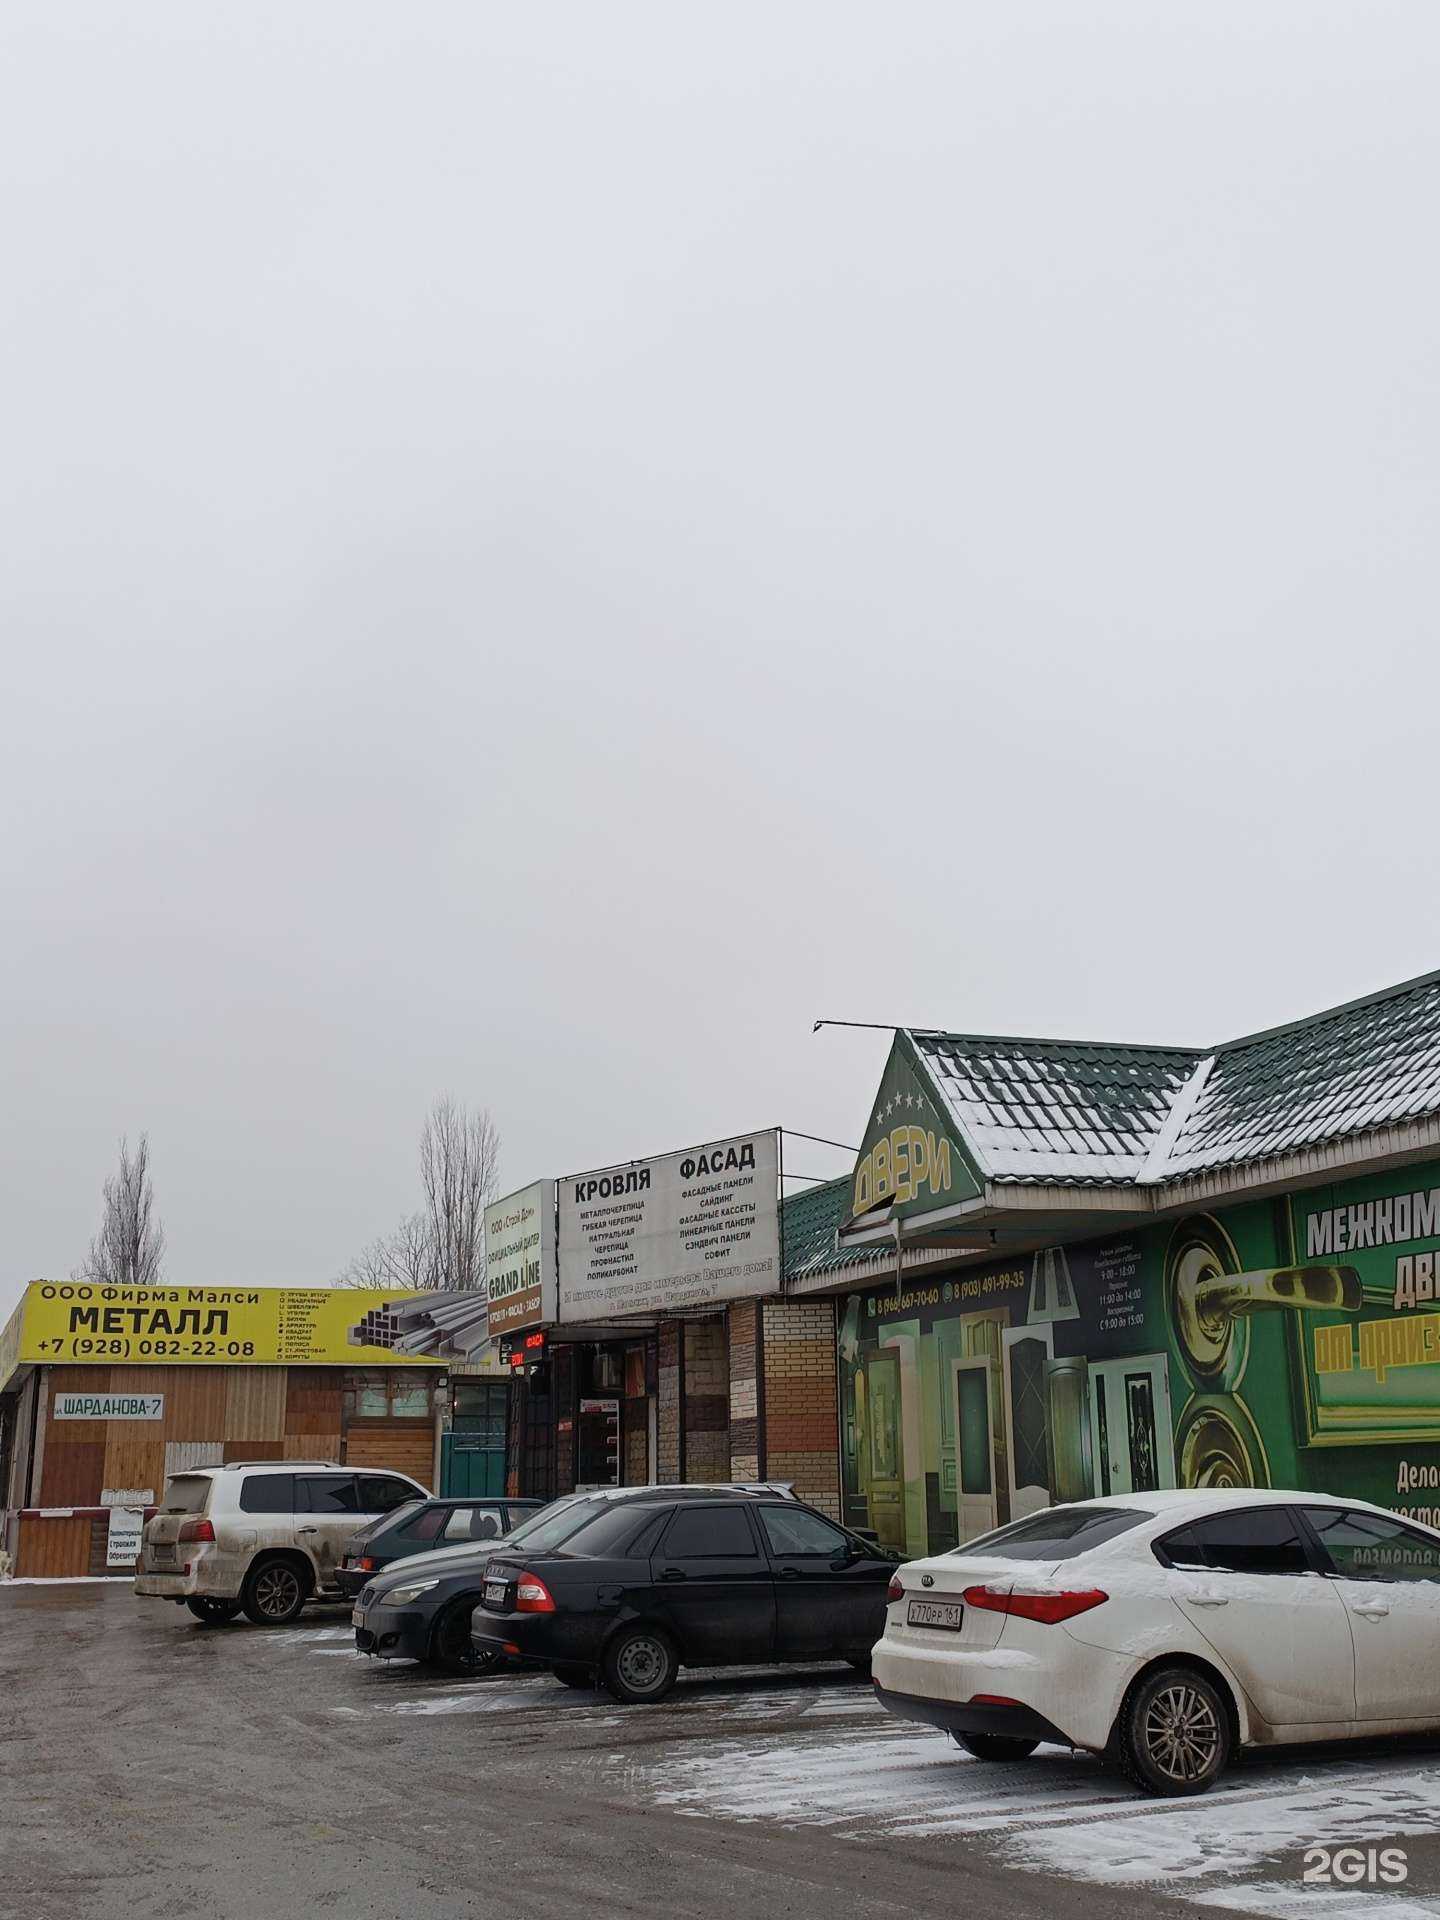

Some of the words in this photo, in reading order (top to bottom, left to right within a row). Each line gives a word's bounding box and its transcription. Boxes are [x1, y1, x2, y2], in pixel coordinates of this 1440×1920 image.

[680, 1143, 755, 1179] ФАСАД
[853, 1125, 952, 1217] ДВЕРИ
[575, 1168, 651, 1203] КРОВЛЯ
[681, 1183, 722, 1199] ФАСАДНЫЕ
[723, 1176, 754, 1190] ПАНЕЛИ
[580, 1200, 645, 1219] МЕТАЛЛОЧЕРЕПИЦА
[699, 1193, 734, 1208] САЙДИНГ
[582, 1220, 607, 1232] ГИБКАЯ
[608, 1213, 643, 1227] ЧЕРЕПИЦА
[679, 1210, 720, 1225] ФАСАДНЫЕ
[721, 1202, 756, 1216] КАССЕТЫ
[1306, 1187, 1440, 1258] МЕЖКОМ
[588, 1227, 635, 1243] НАТУРАЛЬНАЯ
[679, 1222, 724, 1239] ЛИНЕАРНЫЕ
[725, 1216, 756, 1230] ПАНЕЛИ
[594, 1242, 629, 1254] ЧЕРЕПИЦА
[685, 1237, 719, 1251] СЭНДВИЧ
[720, 1231, 751, 1245] ПАНЕЛИ
[590, 1253, 635, 1268] ПРОФНАСТИЛ
[704, 1249, 731, 1261] СОФИТ
[489, 1270, 519, 1300] GRAND
[520, 1260, 540, 1290] LINE
[587, 1266, 639, 1281] ПОЛИКАРБОНАТ
[41, 1286, 93, 1300] ООО
[101, 1286, 179, 1304] Фирма
[188, 1289, 259, 1304] Малси
[954, 1285, 960, 1298] 8
[961, 1280, 981, 1300] (903)
[982, 1271, 1024, 1294] 491-99-35
[69, 1306, 228, 1335] МЕТАЛЛ
[38, 1339, 64, 1354] +7
[72, 1338, 130, 1357] (928)
[139, 1340, 255, 1356] 082-22-08
